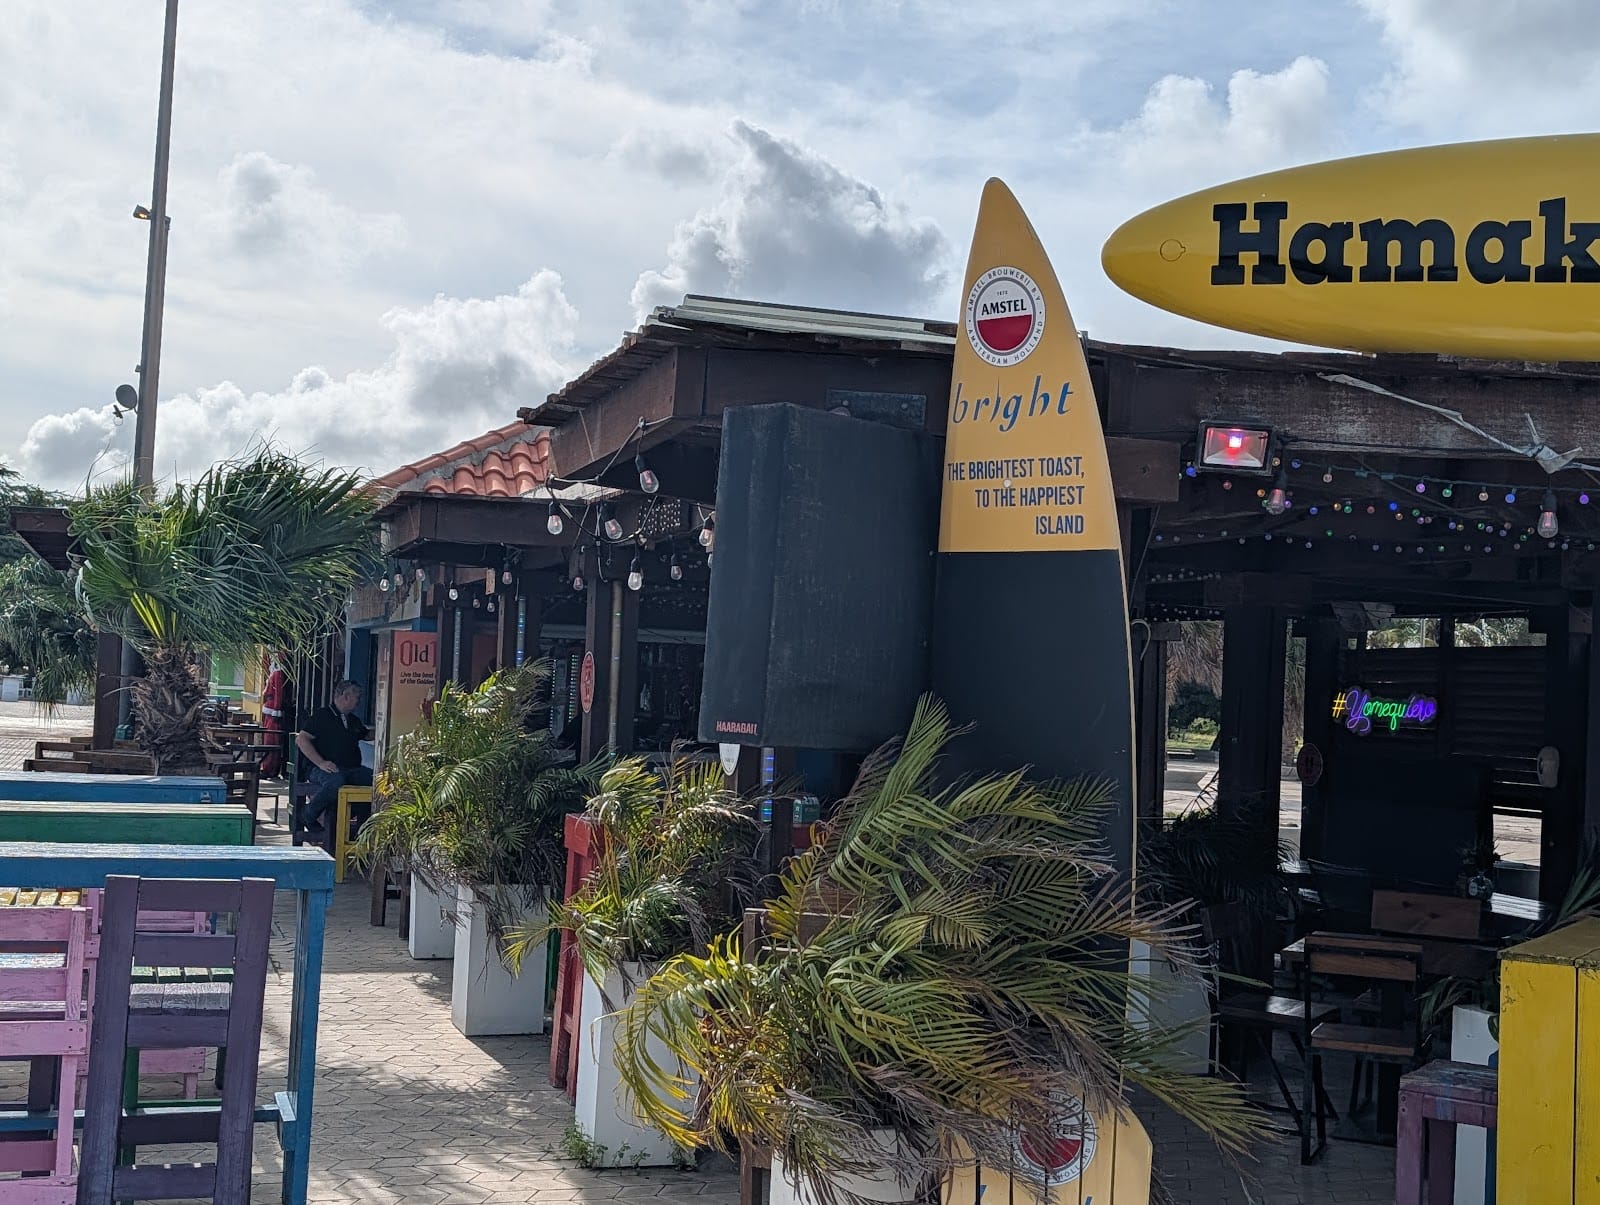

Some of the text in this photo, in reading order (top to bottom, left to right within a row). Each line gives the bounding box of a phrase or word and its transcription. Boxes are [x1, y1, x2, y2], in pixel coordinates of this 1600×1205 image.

[1211, 197, 1600, 285] Hamak
[968, 280, 985, 311] AMSTEL
[981, 299, 1027, 316] AMSTEL
[968, 321, 1043, 364] AMSTERDAM HOLLAND
[952, 375, 1074, 432] bright
[948, 456, 1085, 480] THE BRIGHTEST TOAST,
[975, 485, 1085, 508] TO THE HAPPIEST
[1035, 515, 1084, 535] ISLAND
[400, 640, 429, 667] Old
